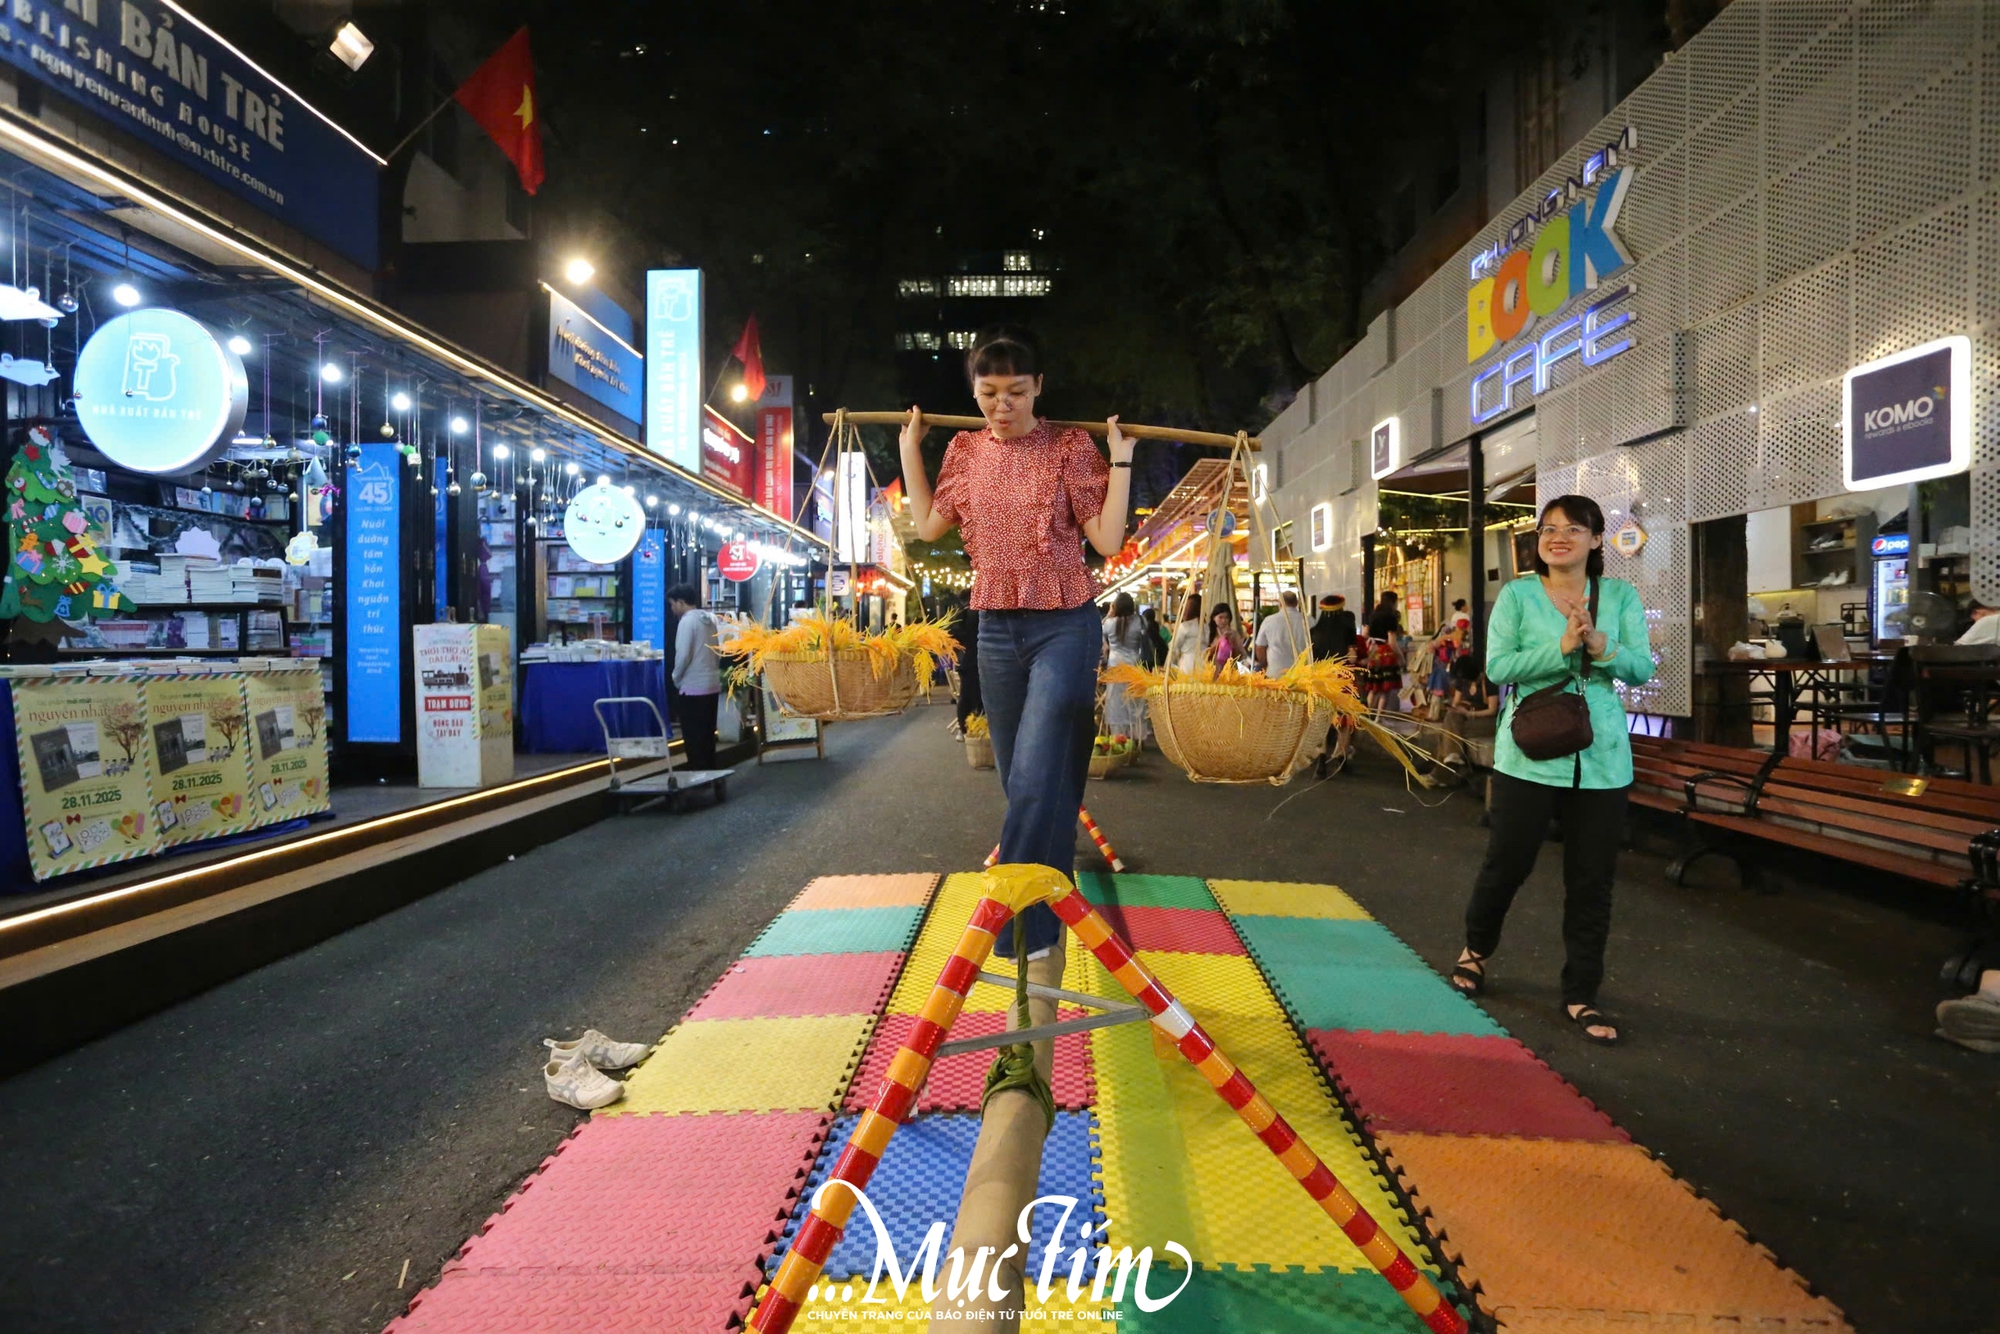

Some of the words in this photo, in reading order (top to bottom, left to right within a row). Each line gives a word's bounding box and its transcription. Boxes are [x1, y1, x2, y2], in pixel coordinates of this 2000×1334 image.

[0, 0, 164, 107] BLISHING
[179, 101, 250, 161] HOUSE
[121, 0, 208, 101] BẢN
[220, 71, 284, 152] TRẺ
[1468, 166, 1637, 365] BOOK
[1471, 284, 1637, 425] CAFE
[1865, 397, 1934, 432] KOMO
[359, 482, 388, 504] 45
[1887, 540, 1908, 551] pep
[271, 760, 308, 774] 28.11.2025
[172, 774, 223, 791] 28.11.2025
[61, 790, 122, 810] 28.11.2025
